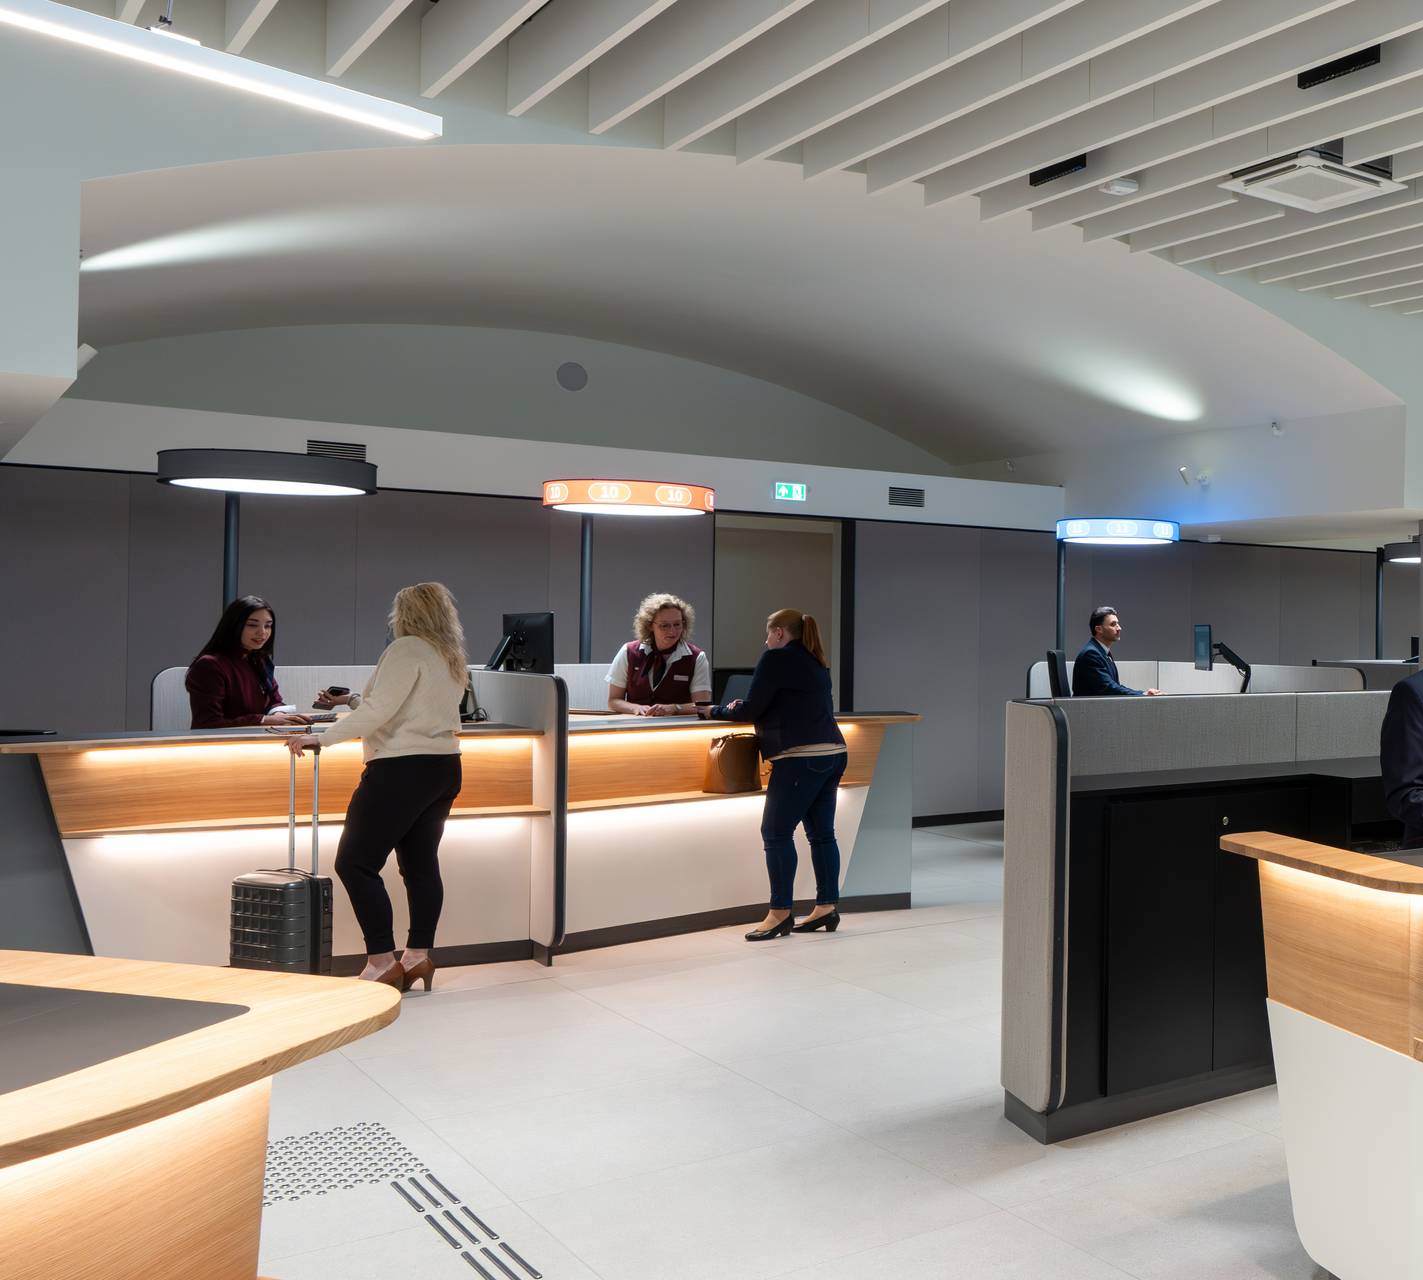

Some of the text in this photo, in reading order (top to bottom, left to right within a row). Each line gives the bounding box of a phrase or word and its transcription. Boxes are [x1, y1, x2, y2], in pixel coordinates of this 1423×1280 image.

[550, 486, 561, 499] 10
[601, 486, 618, 499] 10
[668, 489, 683, 502] 10
